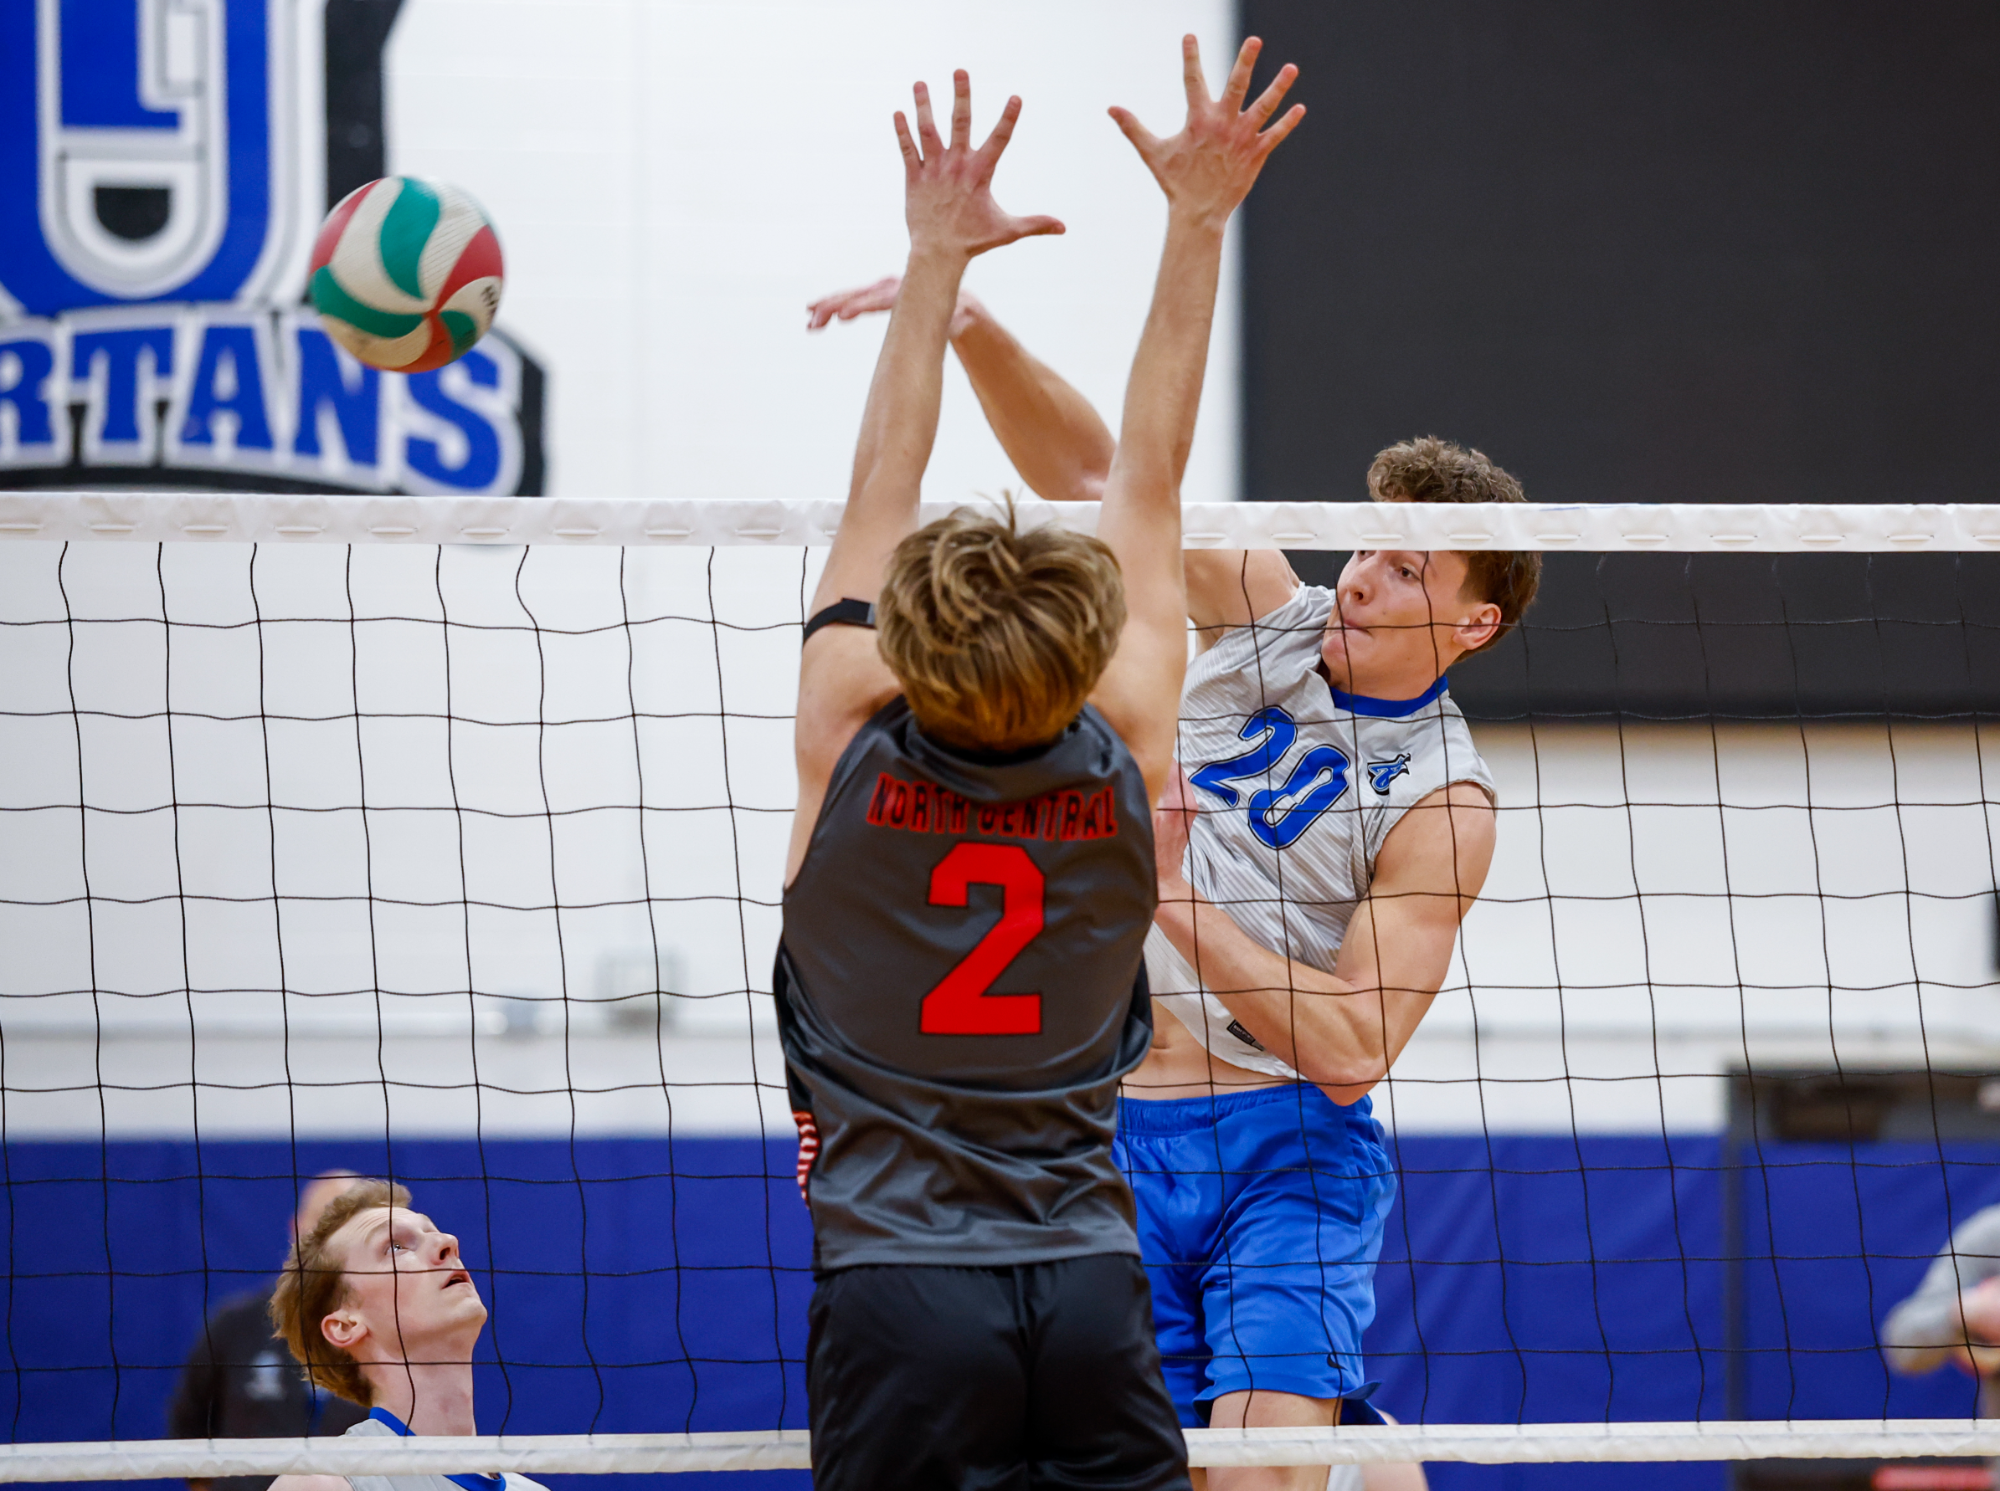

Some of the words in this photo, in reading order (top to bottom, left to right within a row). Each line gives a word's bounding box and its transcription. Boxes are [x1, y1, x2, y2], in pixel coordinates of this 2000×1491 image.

[866, 772, 970, 834] NORTH
[1188, 704, 1350, 850] 20
[918, 841, 1046, 1036] 2
